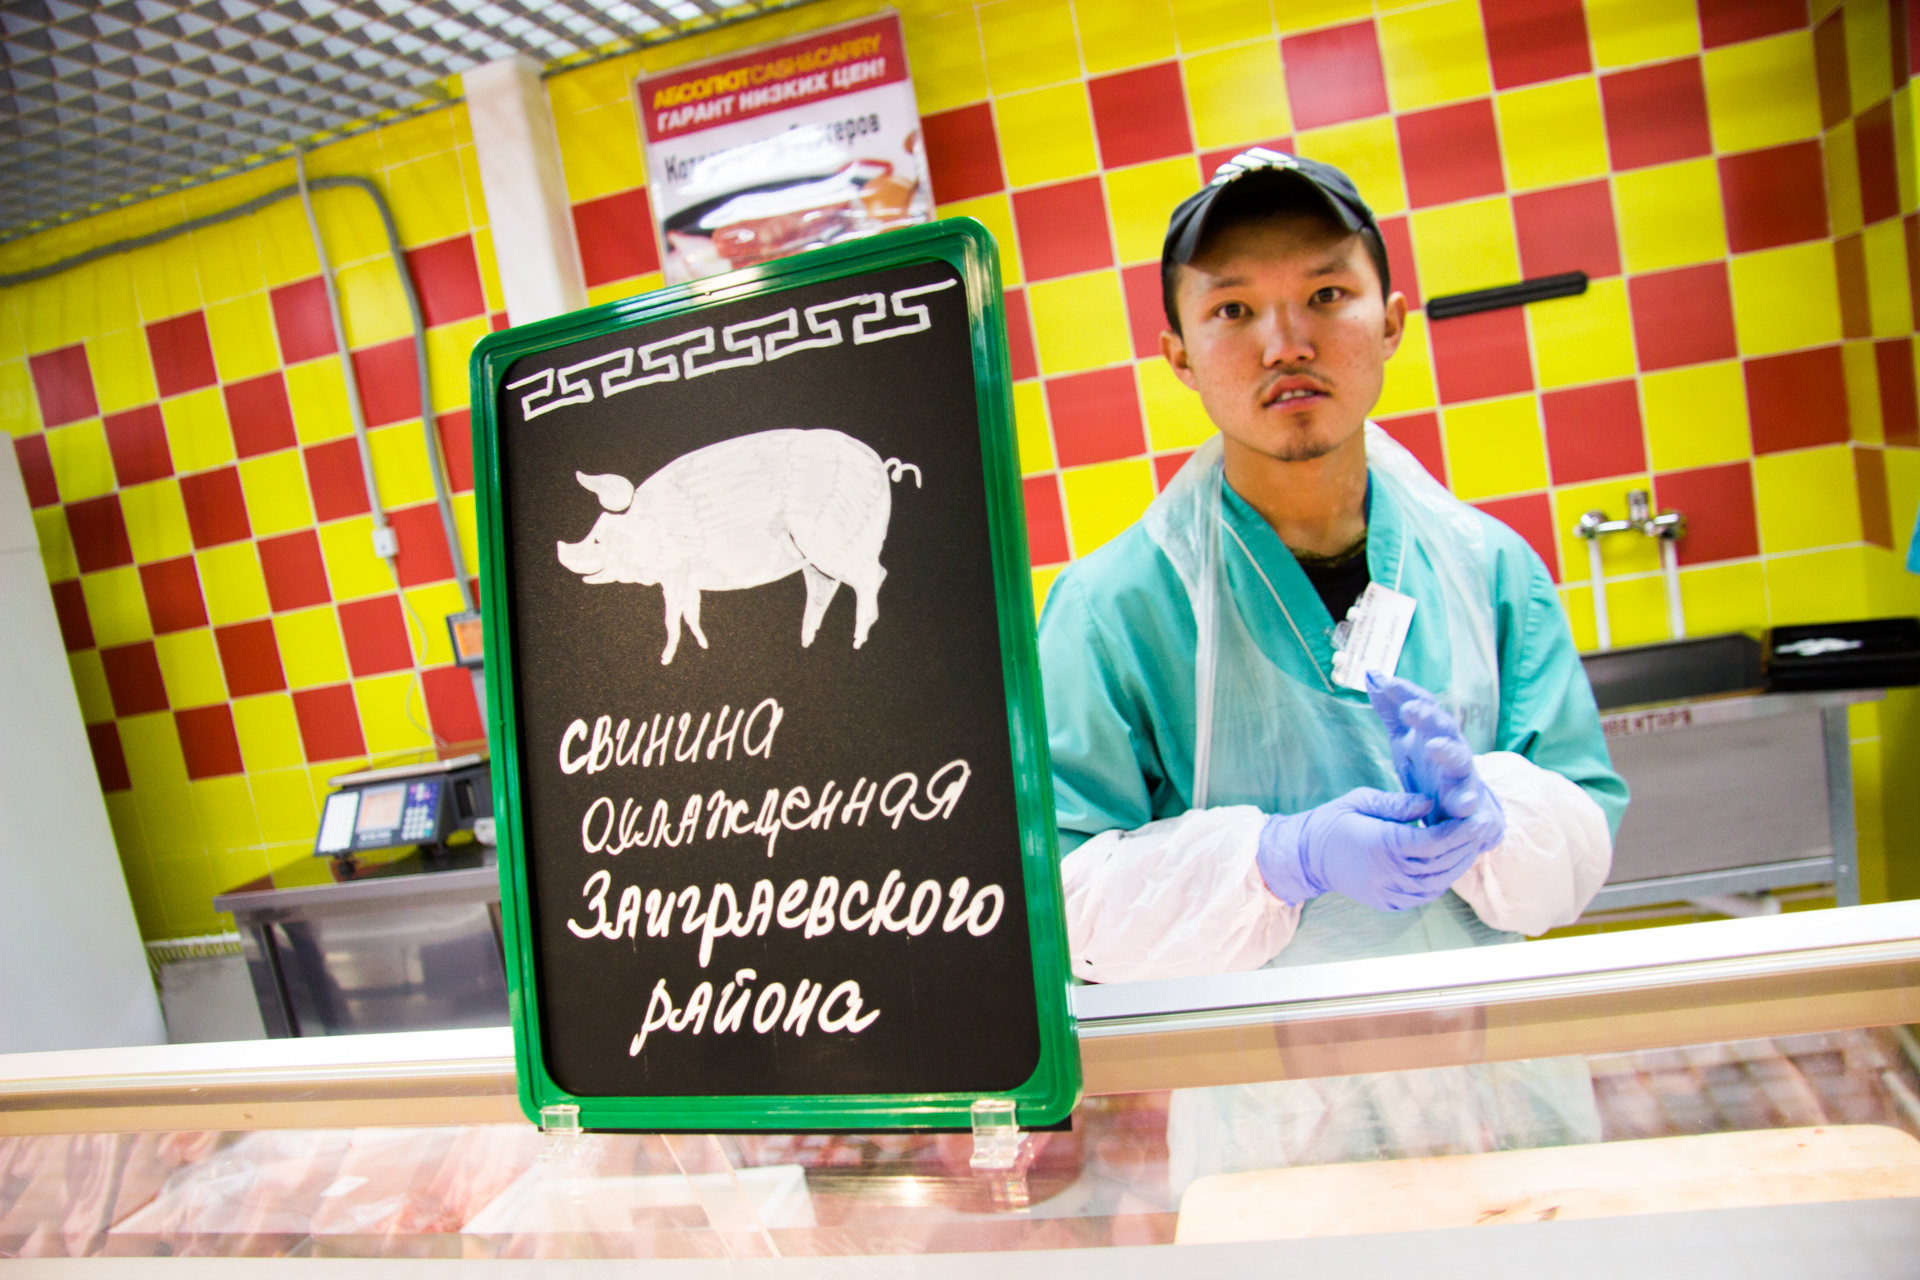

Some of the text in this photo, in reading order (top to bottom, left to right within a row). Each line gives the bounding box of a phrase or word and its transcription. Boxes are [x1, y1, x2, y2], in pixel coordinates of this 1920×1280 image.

[656, 56, 887, 133] ГАРАНТ НИЗКИХ ЦЕН!
